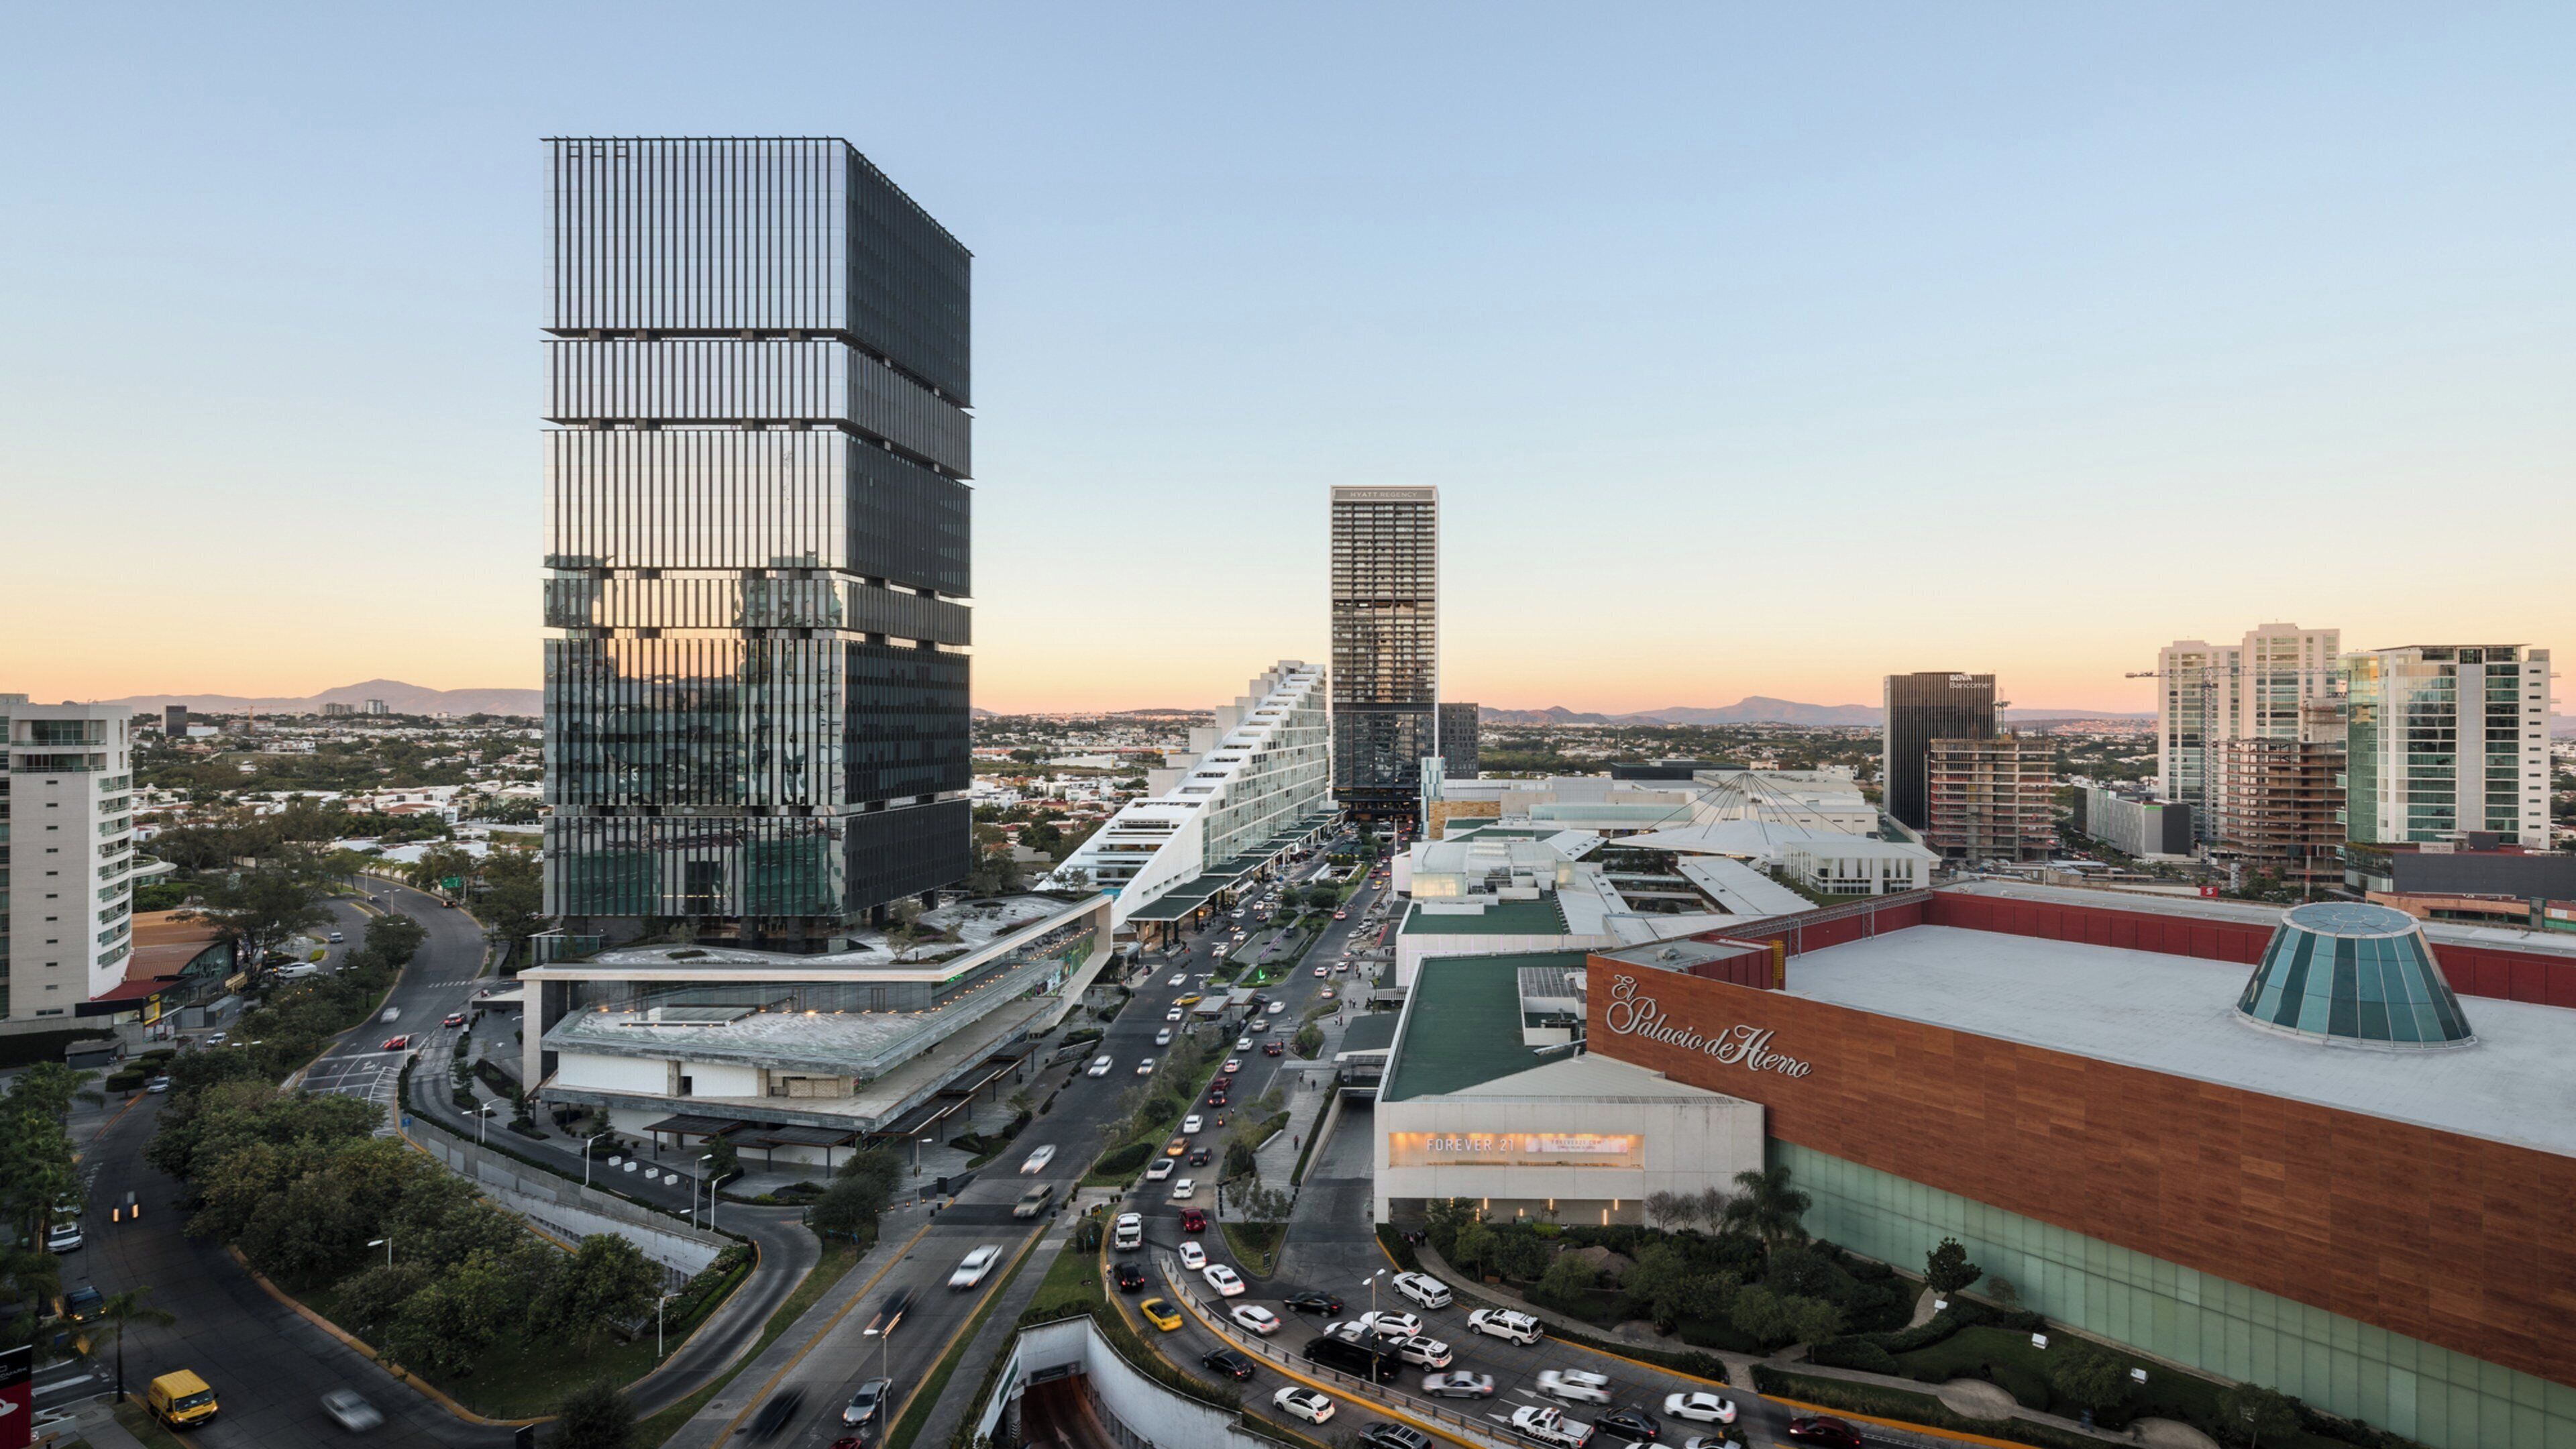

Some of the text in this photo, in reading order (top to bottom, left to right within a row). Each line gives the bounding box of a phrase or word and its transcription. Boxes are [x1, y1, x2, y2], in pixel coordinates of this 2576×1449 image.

[1611, 974, 1638, 1001] El
[1607, 996, 1813, 1079] Palacio de Hierro
[1426, 1138, 1514, 1152] FOREVER 21
